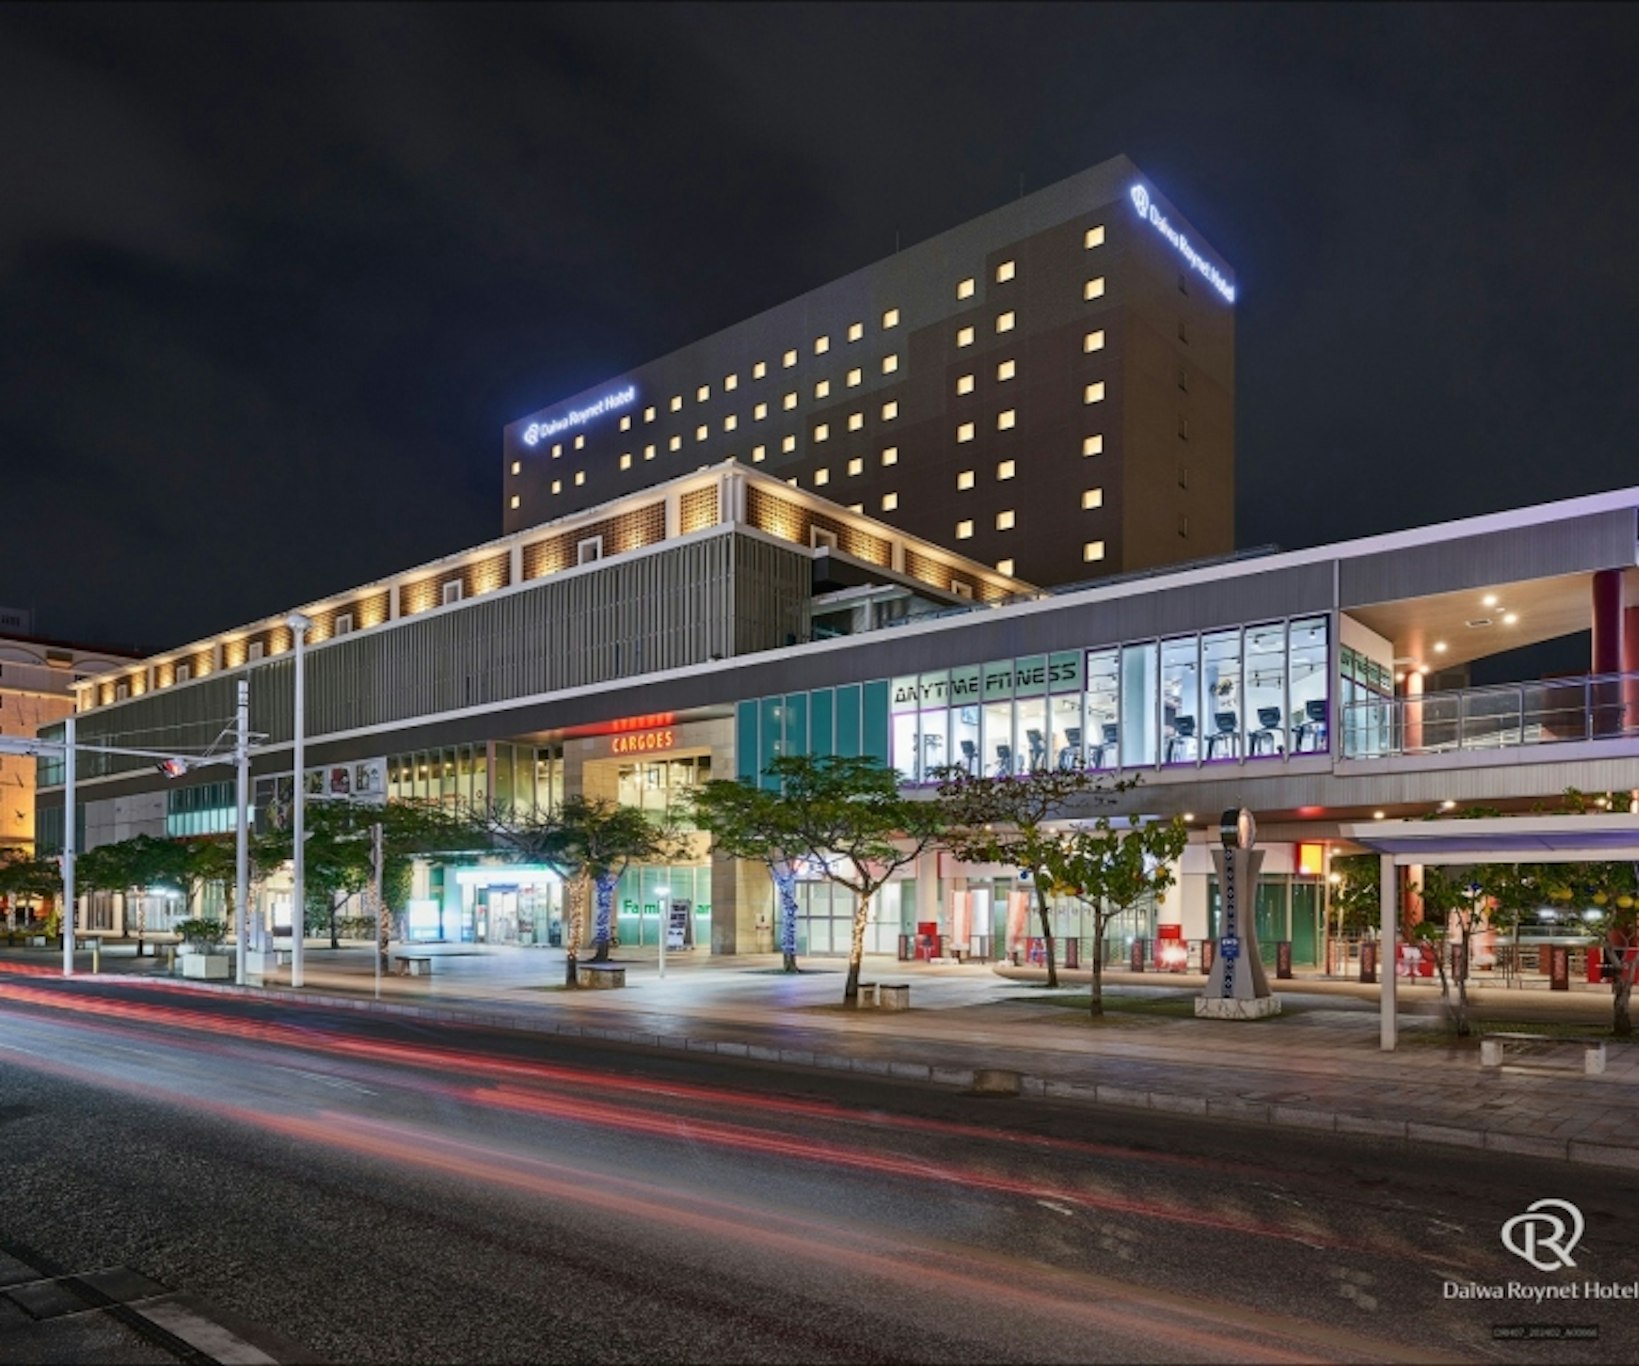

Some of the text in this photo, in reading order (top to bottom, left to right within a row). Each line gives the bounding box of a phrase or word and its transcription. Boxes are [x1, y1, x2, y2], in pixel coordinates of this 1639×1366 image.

[894, 661, 1077, 703] ANYTIME FITNESS
[611, 730, 673, 753] CARGOES
